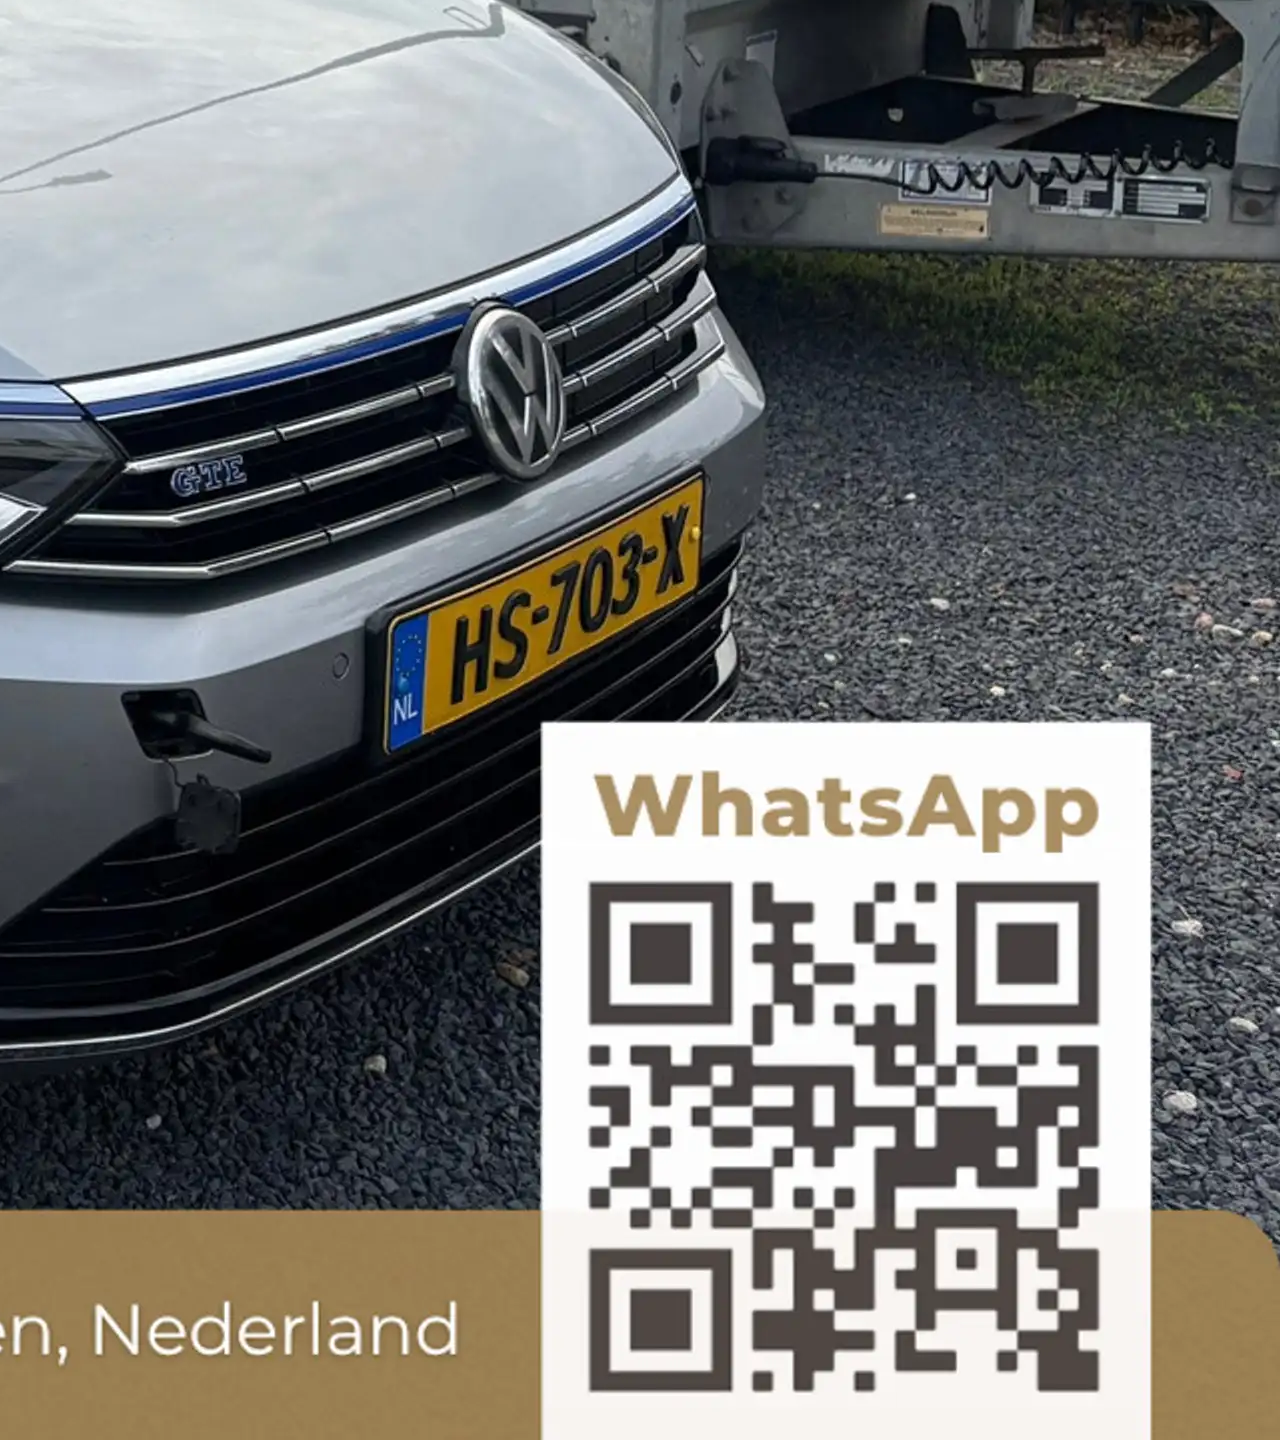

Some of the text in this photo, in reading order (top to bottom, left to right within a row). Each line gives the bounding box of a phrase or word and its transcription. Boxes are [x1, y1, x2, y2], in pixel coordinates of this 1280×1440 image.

[171, 455, 248, 497] GTE
[449, 503, 689, 705] HS-703-X
[393, 693, 419, 726] NL
